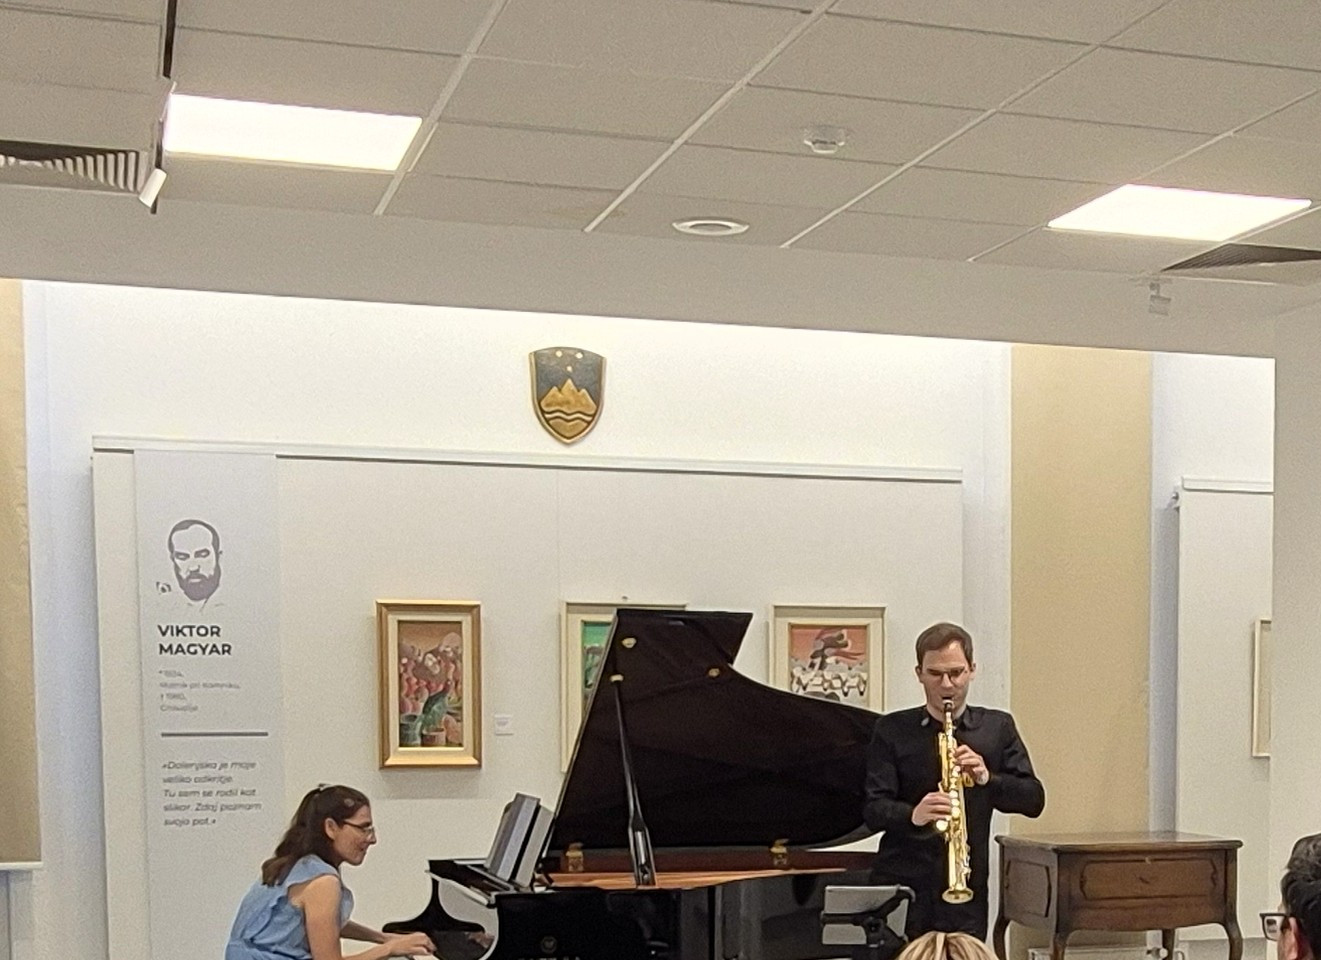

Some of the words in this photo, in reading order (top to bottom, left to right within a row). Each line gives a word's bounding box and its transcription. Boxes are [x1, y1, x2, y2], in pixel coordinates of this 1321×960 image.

[157, 624, 221, 638] VIKTOR
[159, 643, 232, 656] MAGYAR
[164, 789, 176, 797] Tu
